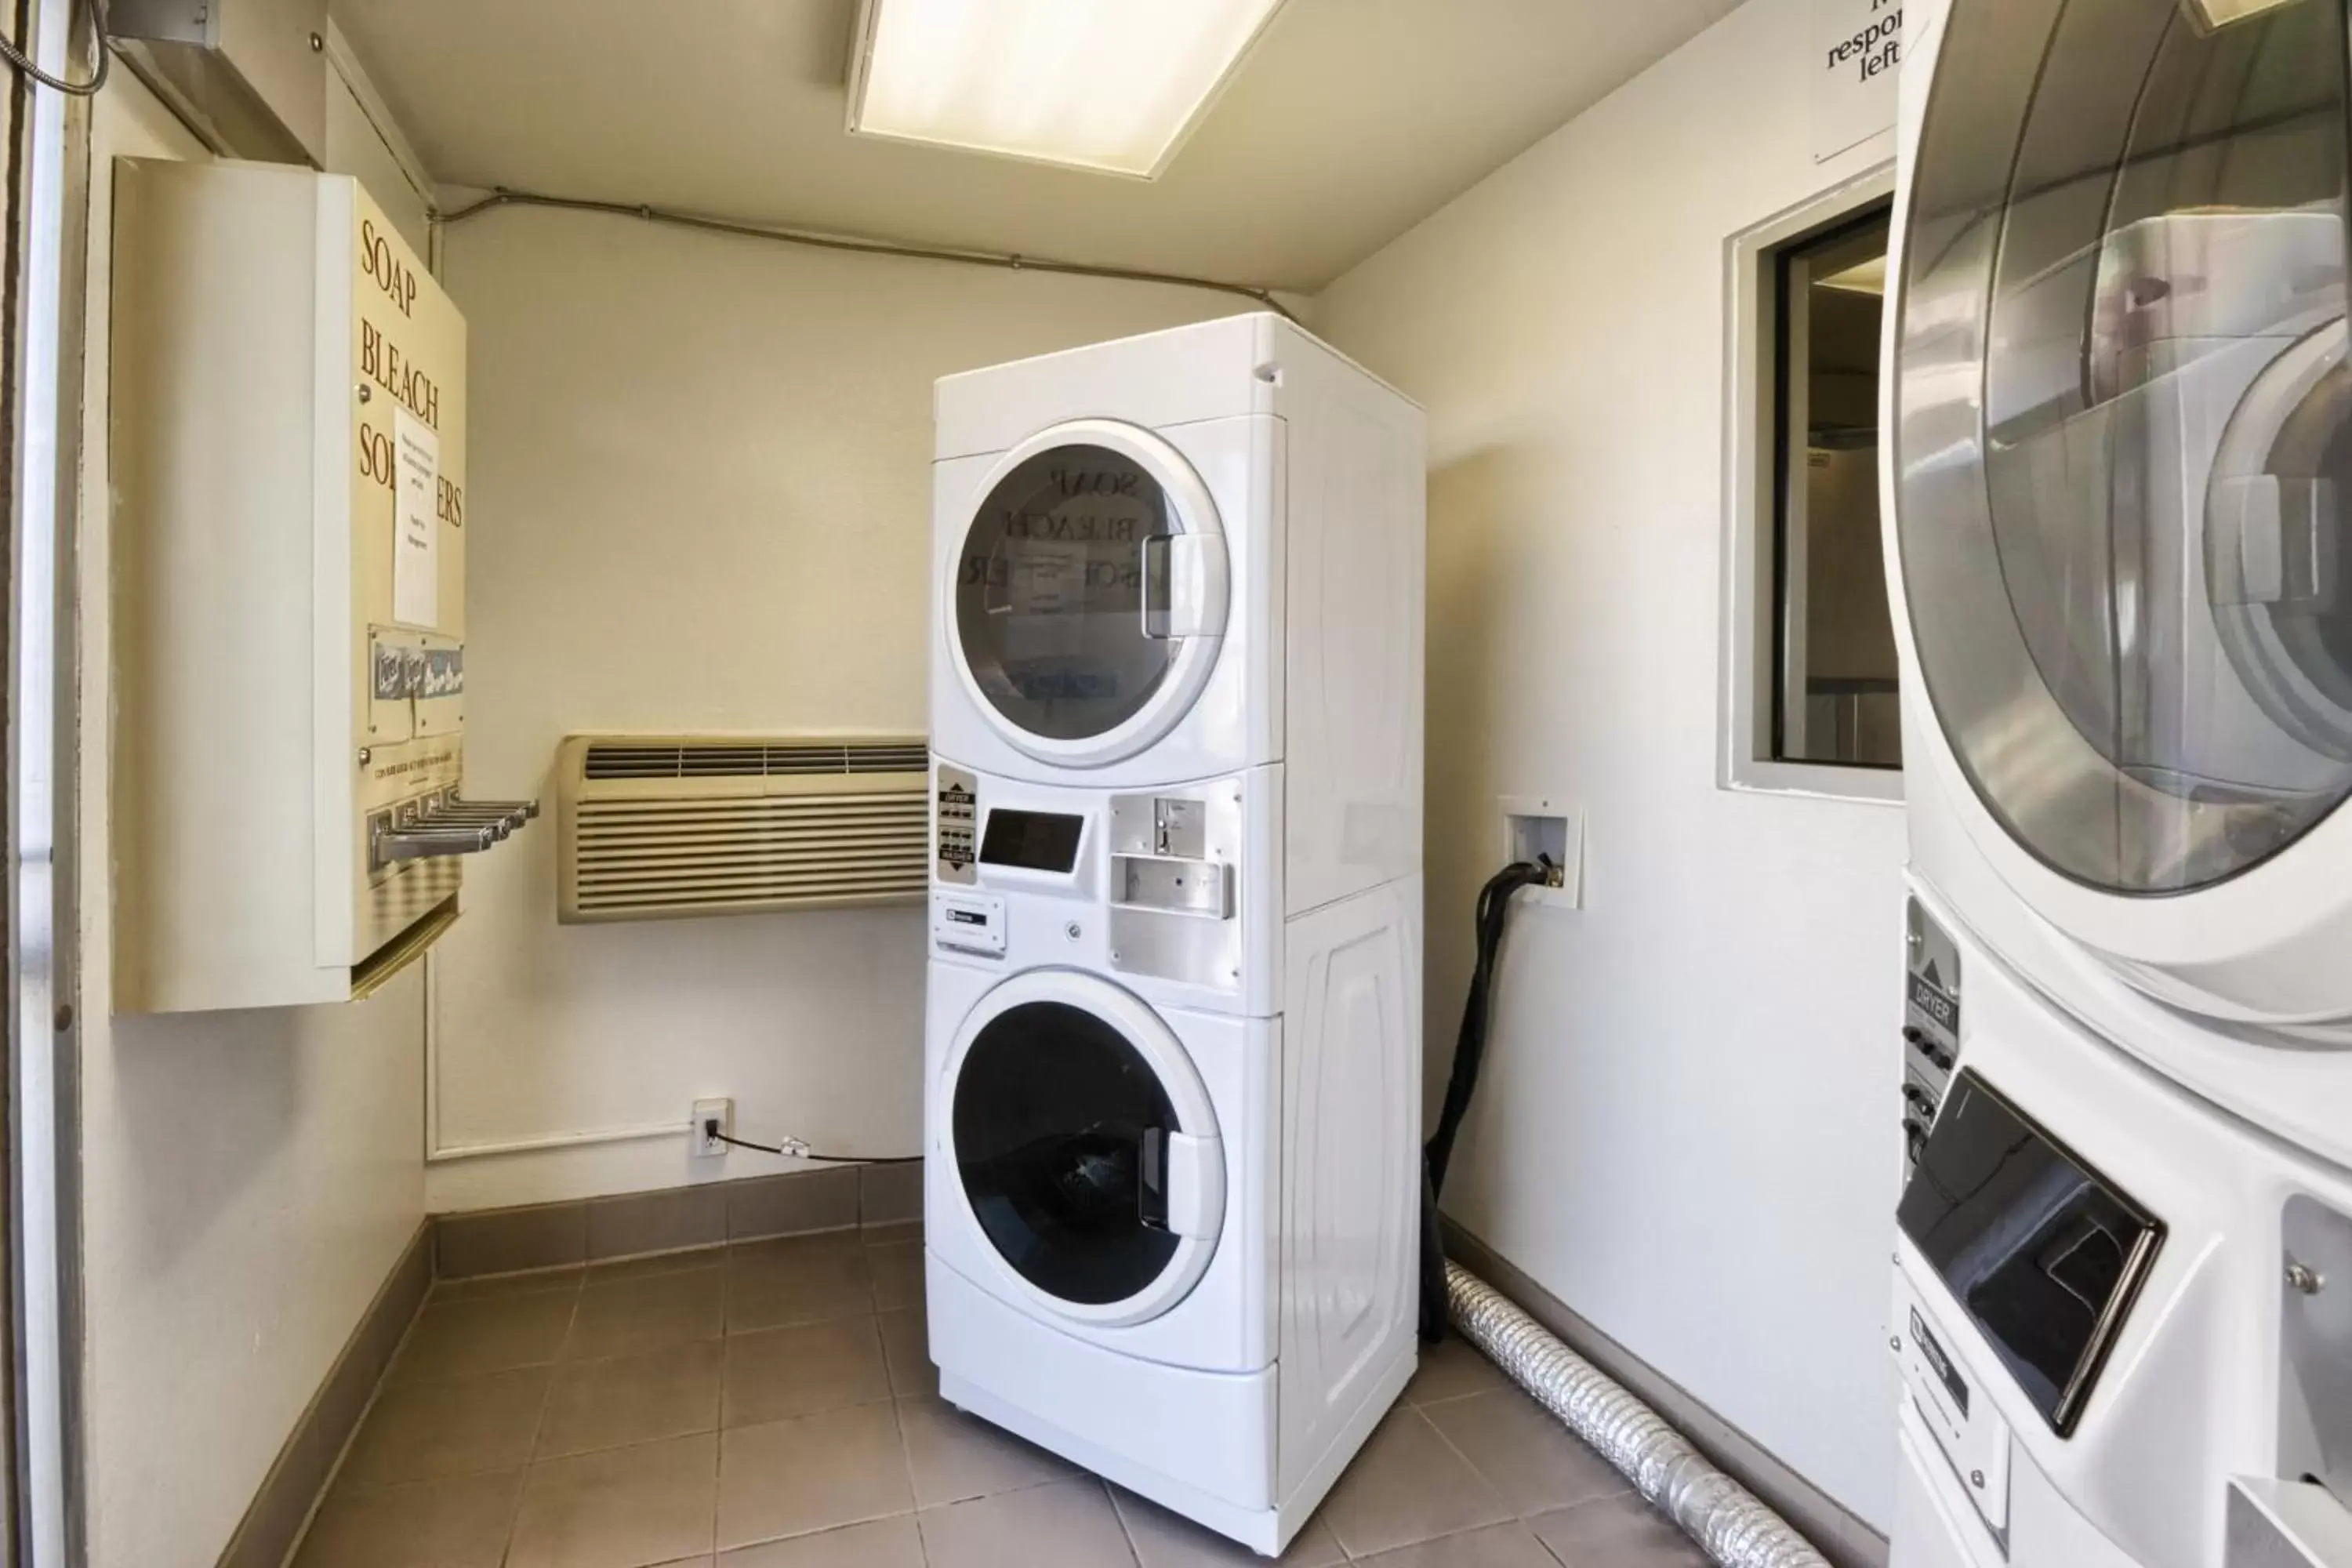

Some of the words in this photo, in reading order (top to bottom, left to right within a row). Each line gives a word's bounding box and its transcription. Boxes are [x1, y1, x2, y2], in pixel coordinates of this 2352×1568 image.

[1859, 40, 1901, 82] left
[362, 220, 416, 319] SOAP
[361, 318, 439, 430] BLEACH
[1915, 983, 1951, 1025] DRYER
